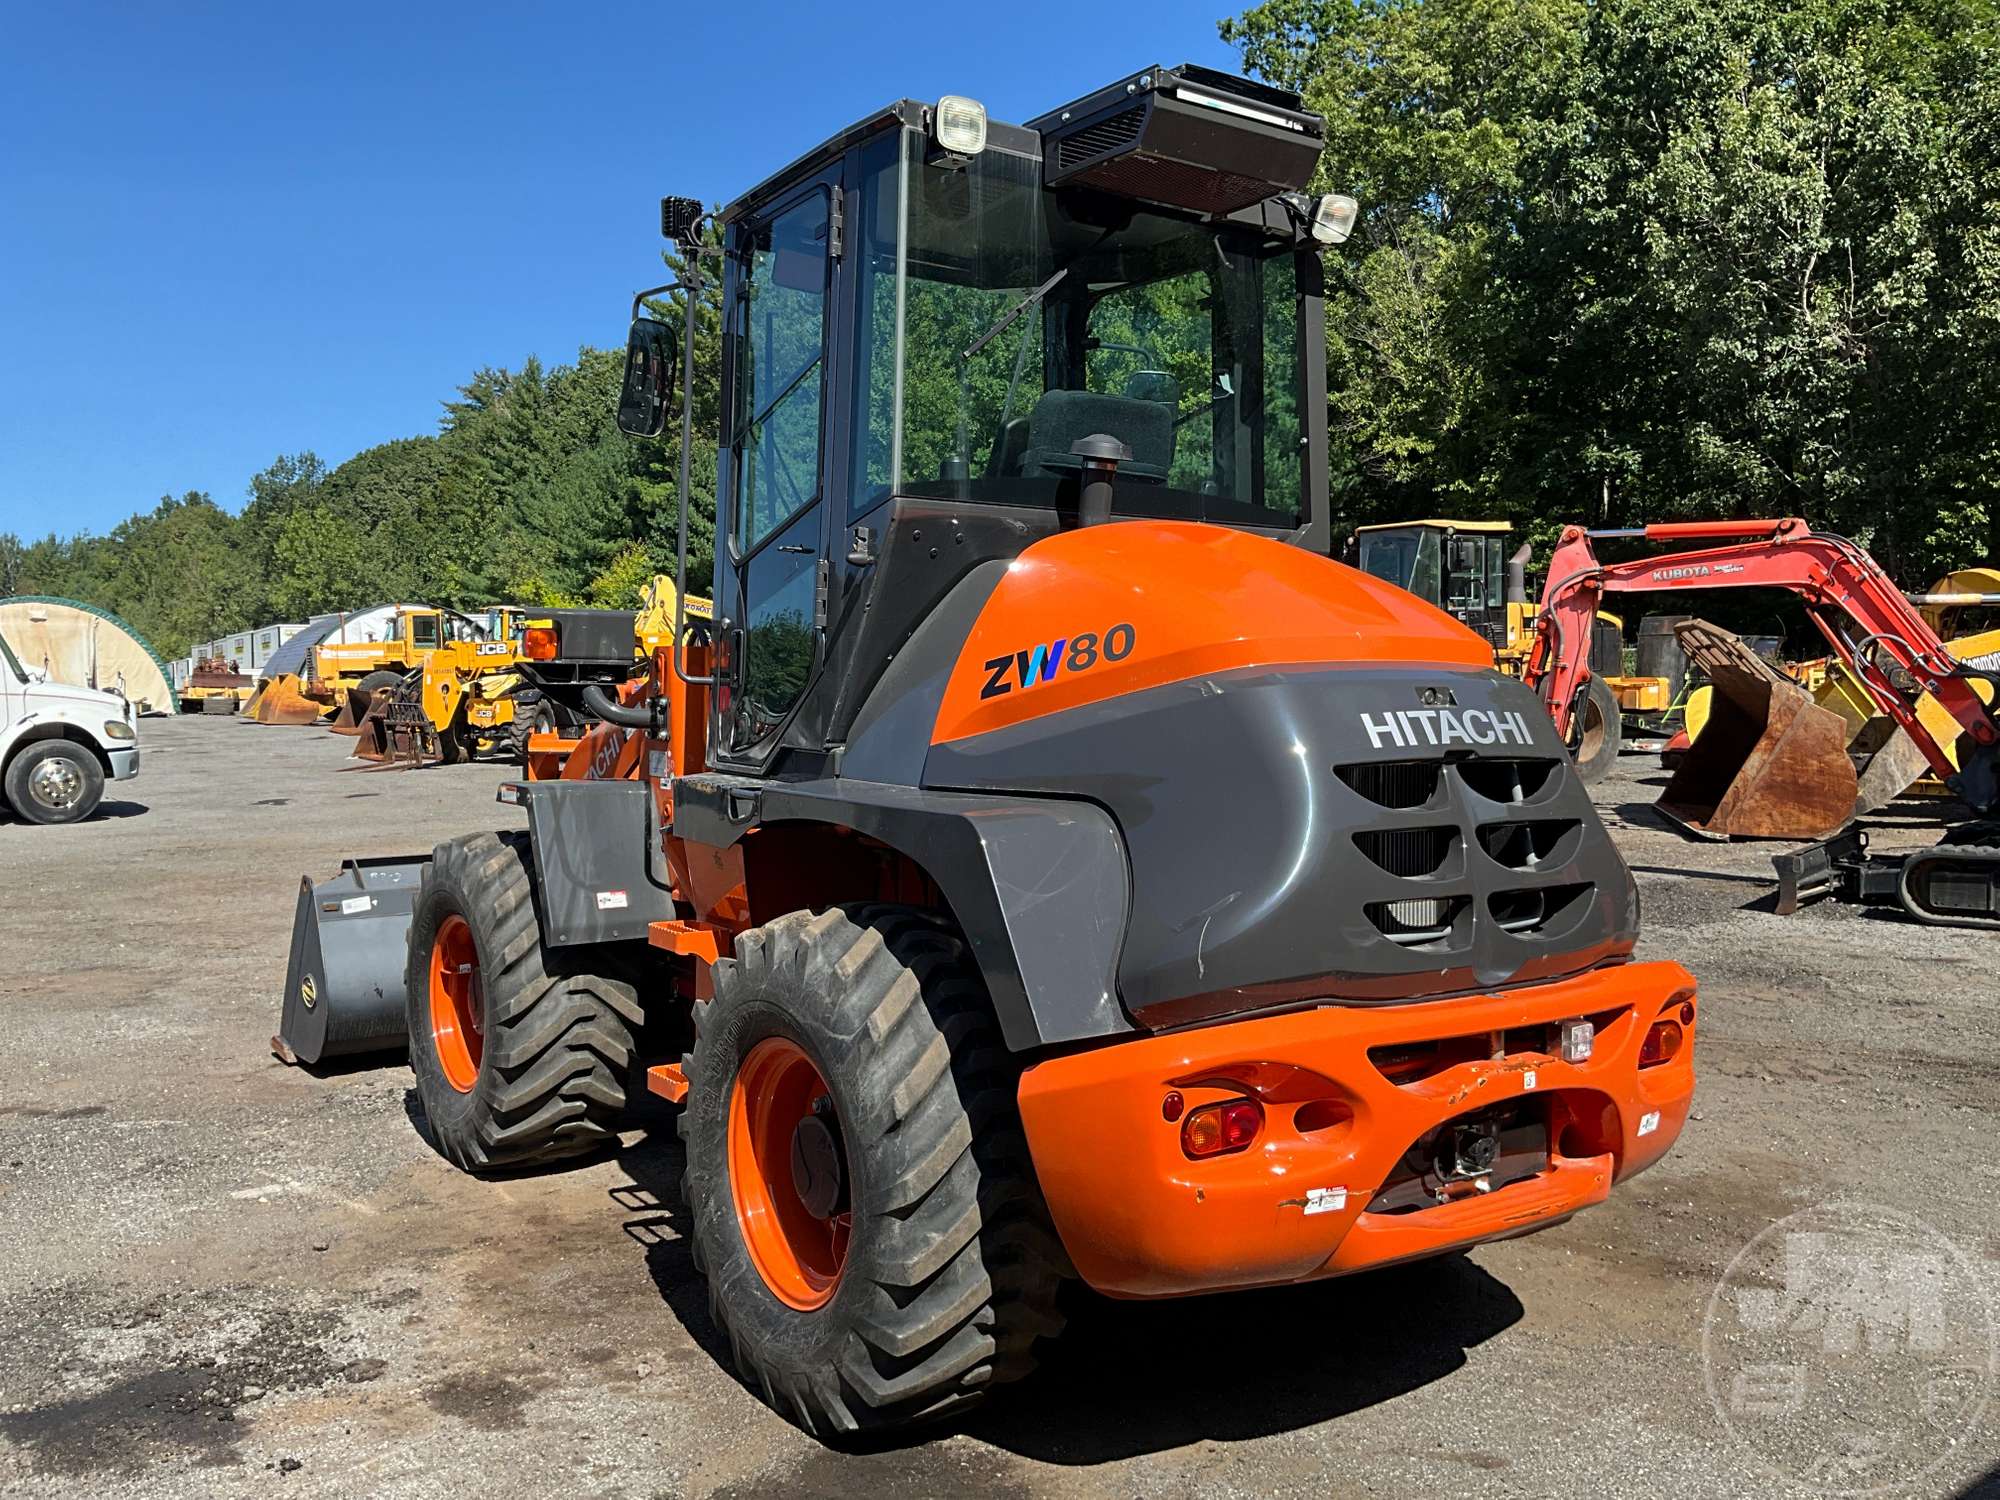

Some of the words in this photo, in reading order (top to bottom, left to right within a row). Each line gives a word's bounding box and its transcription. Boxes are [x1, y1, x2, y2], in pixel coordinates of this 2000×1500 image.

[1652, 566, 1711, 581] KUBOTA
[476, 643, 508, 655] JCB
[980, 623, 1136, 700] ZW80
[1360, 709, 1534, 749] HITACHI
